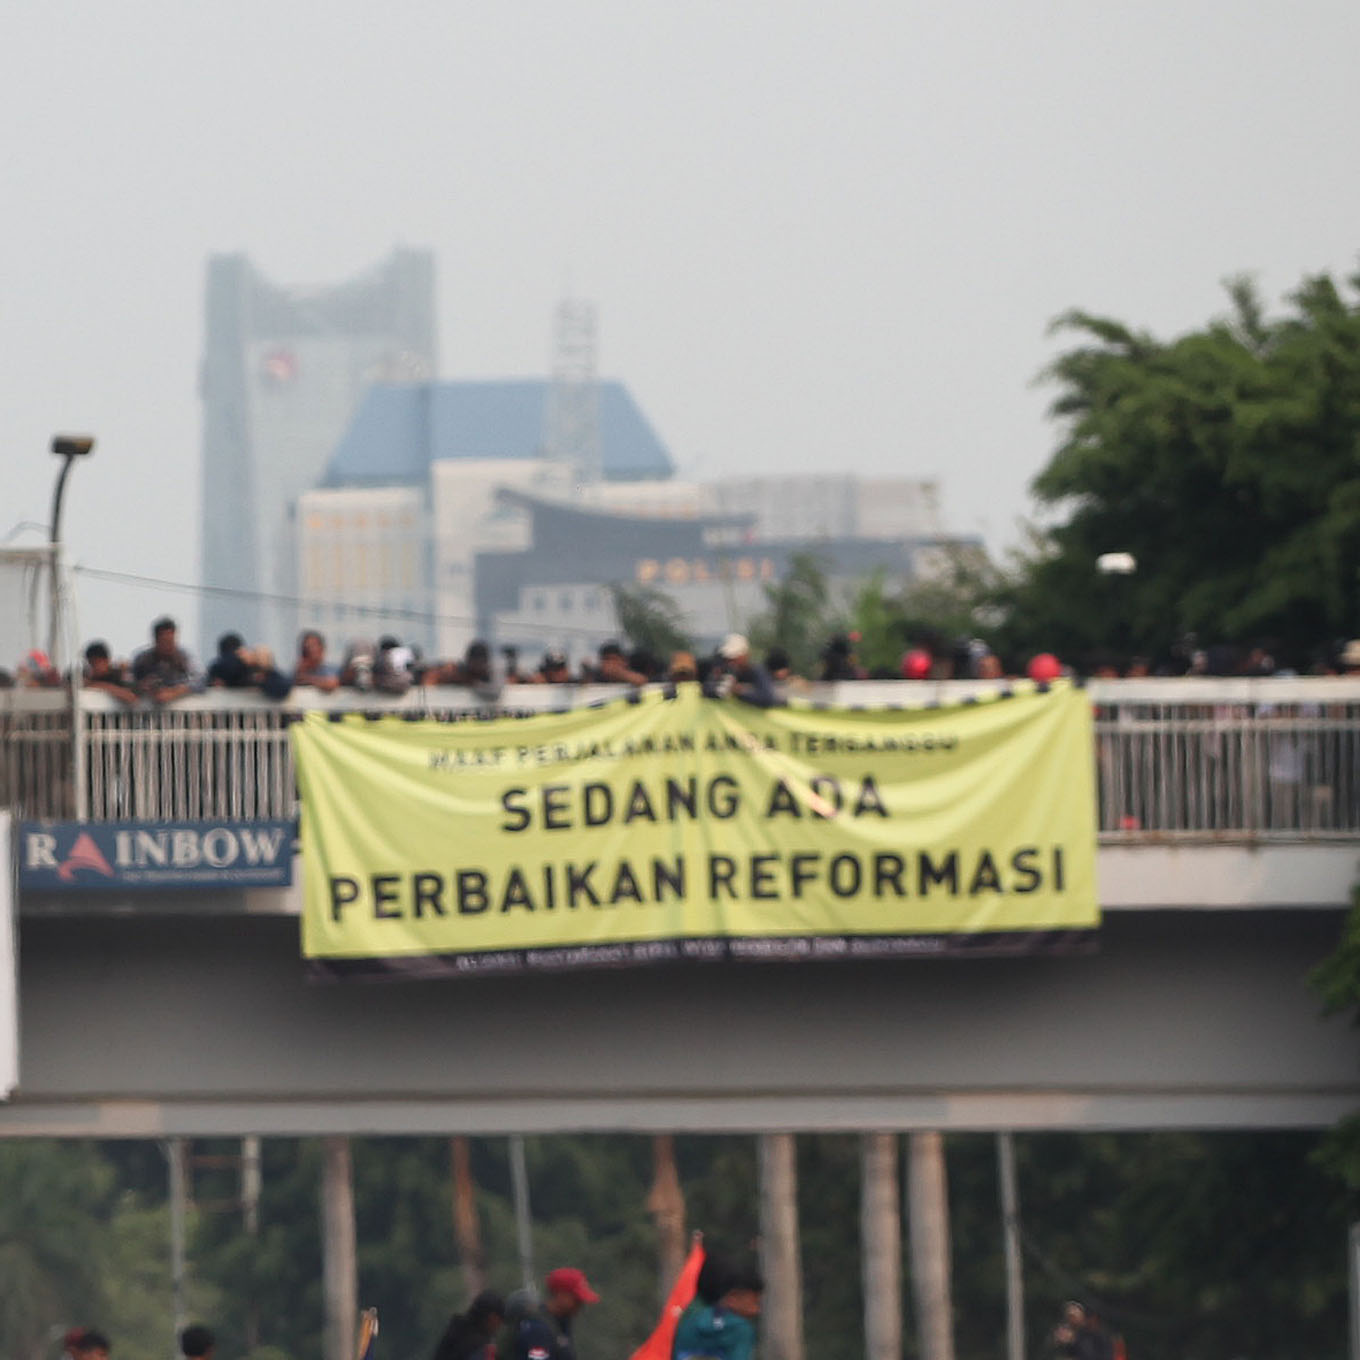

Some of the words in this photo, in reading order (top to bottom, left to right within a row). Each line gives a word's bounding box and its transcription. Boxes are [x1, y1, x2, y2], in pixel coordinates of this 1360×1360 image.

[500, 775, 740, 833] SEDANG
[764, 774, 890, 821] ADA
[25, 827, 284, 882] RAINBOW
[329, 854, 688, 922] PERBAIKAN
[708, 844, 1065, 900] REFORMASI
